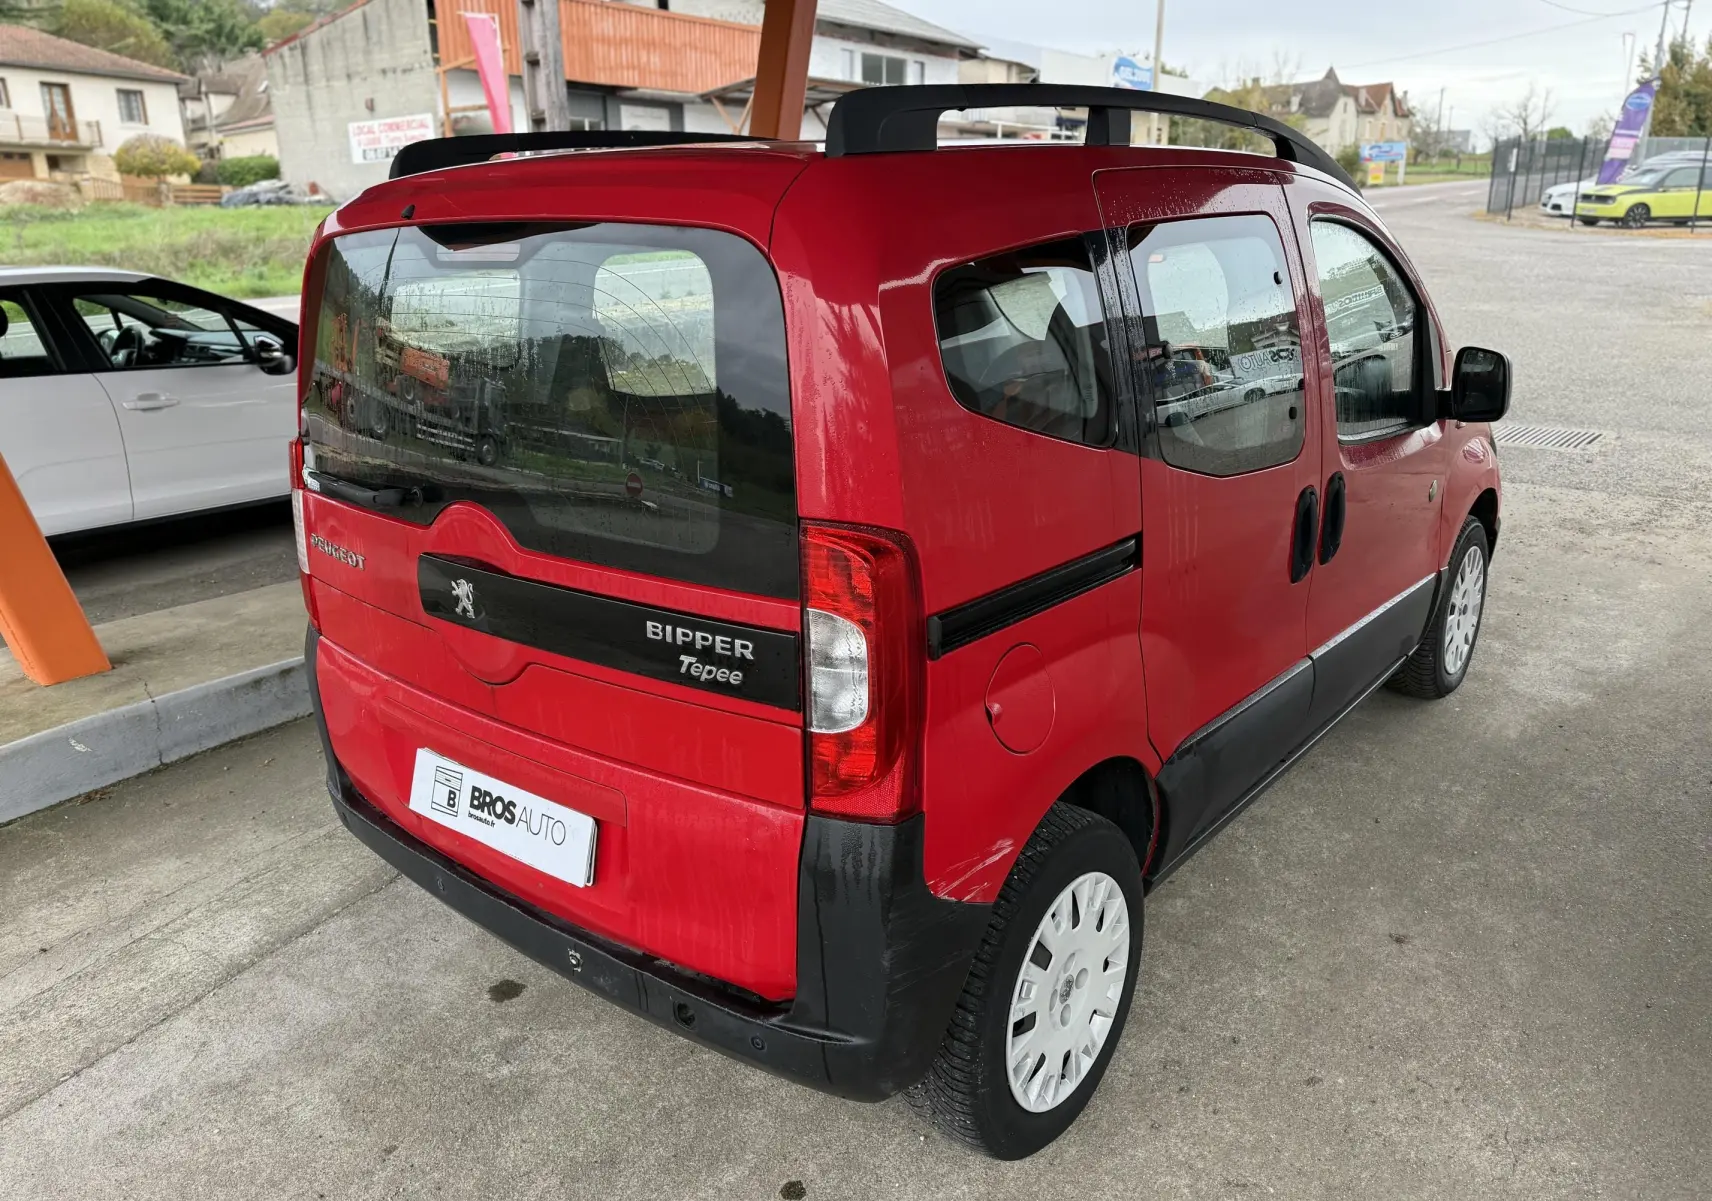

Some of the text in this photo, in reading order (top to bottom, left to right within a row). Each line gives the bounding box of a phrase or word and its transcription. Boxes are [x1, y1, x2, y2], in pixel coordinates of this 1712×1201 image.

[311, 533, 366, 571] PEUGEOT
[646, 620, 754, 660] BIPPER
[679, 654, 744, 685] Tepee
[447, 789, 457, 809] B
[468, 810, 496, 828] brosauto.fr
